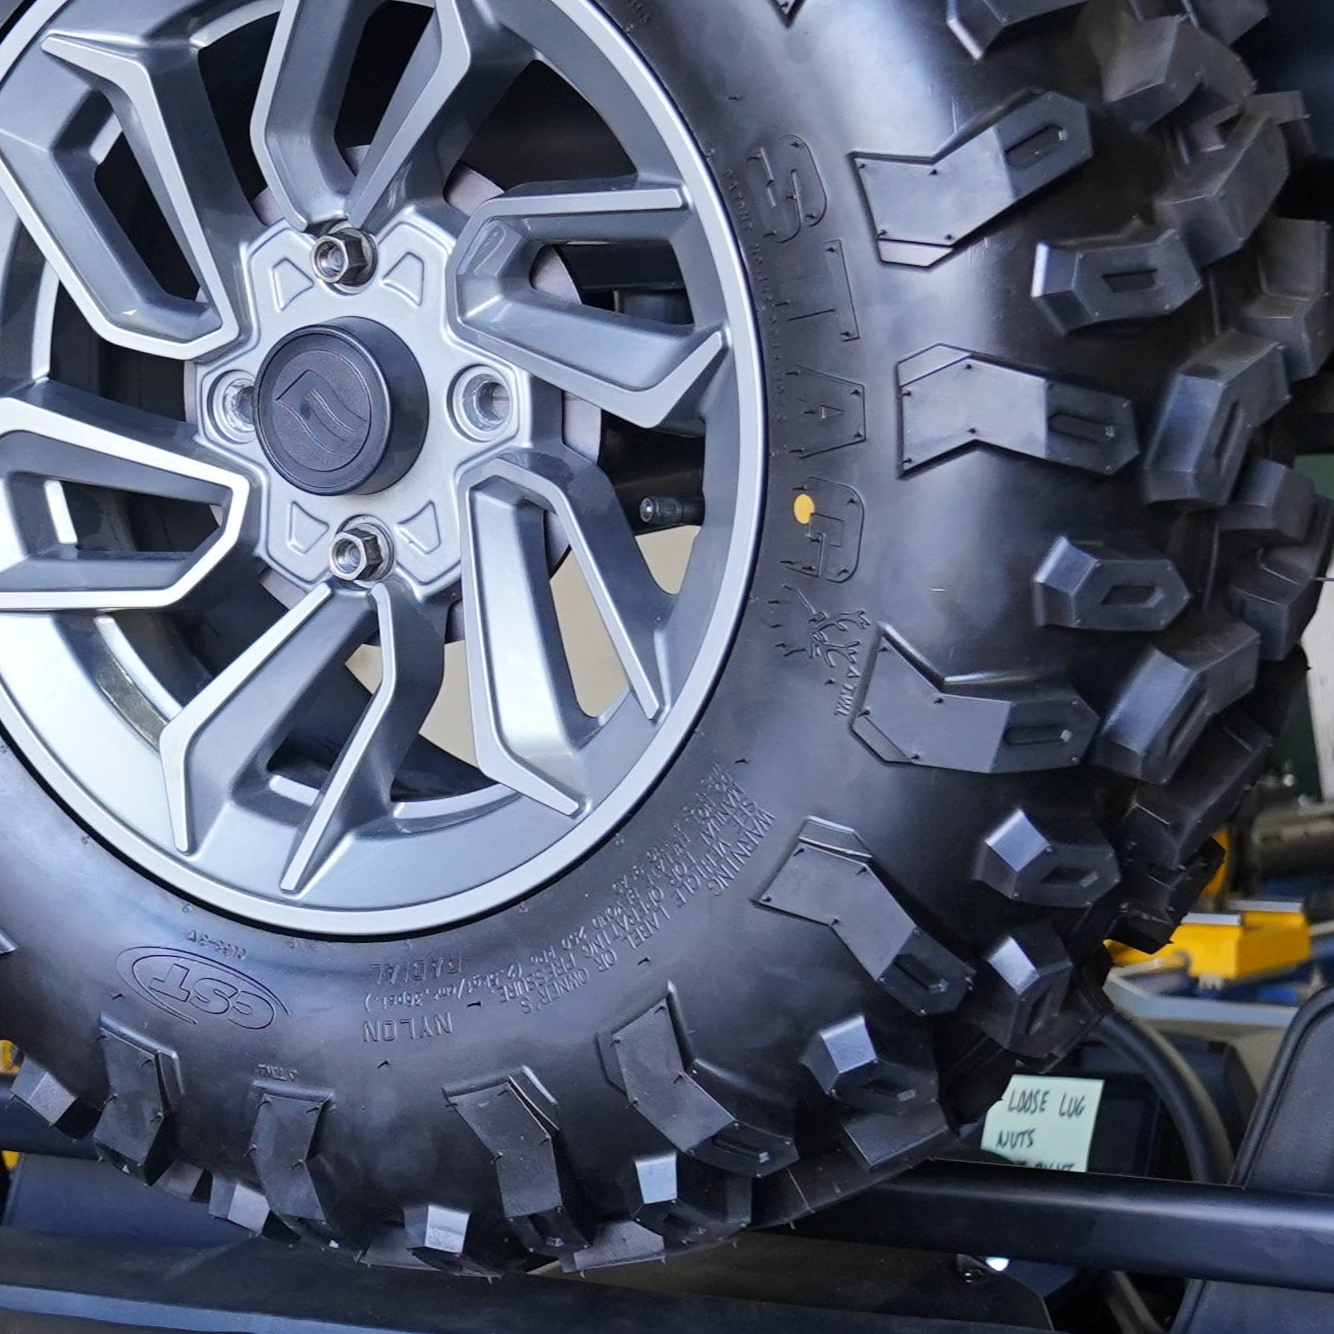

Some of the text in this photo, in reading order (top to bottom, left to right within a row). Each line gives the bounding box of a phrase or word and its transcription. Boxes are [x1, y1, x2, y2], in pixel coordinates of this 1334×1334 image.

[696, 780, 745, 846] MANUAL
[668, 835, 732, 909] VEHICLE
[704, 808, 777, 898] WARNING
[579, 886, 666, 959] OPERATING
[624, 904, 672, 952] LABEL
[370, 952, 461, 985] RADIAL
[589, 946, 621, 975] OR
[148, 963, 274, 1029] CST
[363, 1010, 453, 1043] NYLON
[1007, 1089, 1086, 1118] LOOSE LUG
[995, 1128, 1035, 1149] NUTS
